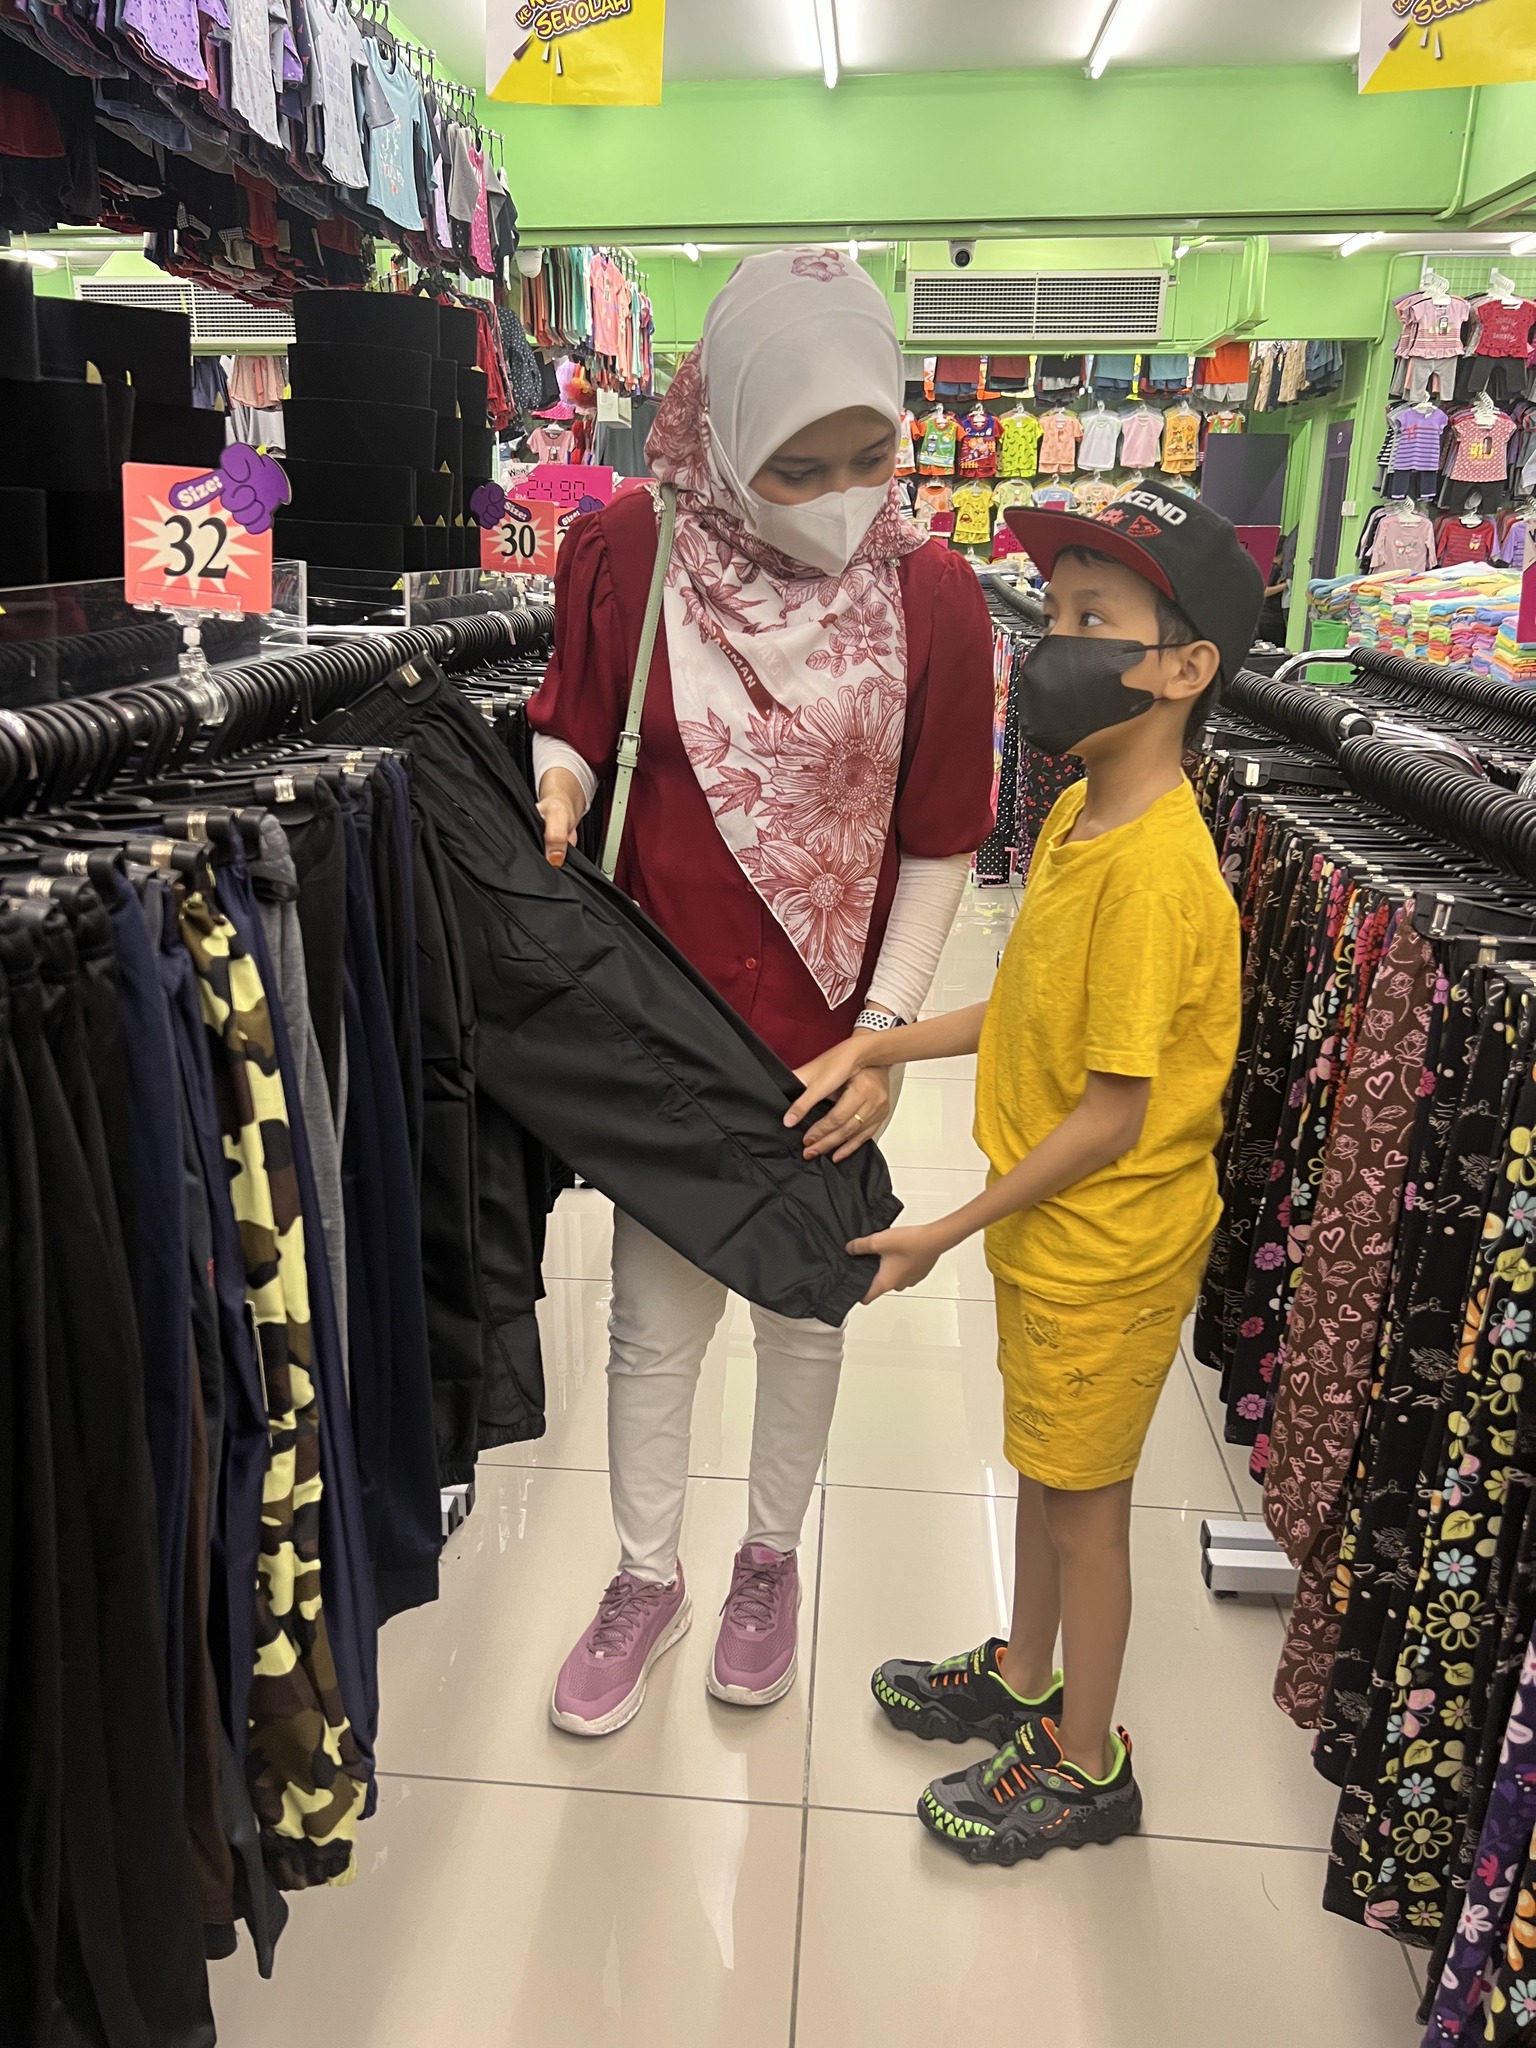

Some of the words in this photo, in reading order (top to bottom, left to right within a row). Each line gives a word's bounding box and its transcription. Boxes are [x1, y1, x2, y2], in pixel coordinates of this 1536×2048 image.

[517, 7, 532, 23] KE
[177, 476, 223, 508] Size:
[503, 501, 528, 521] Size:
[163, 515, 229, 579] 32
[501, 523, 536, 558] 30
